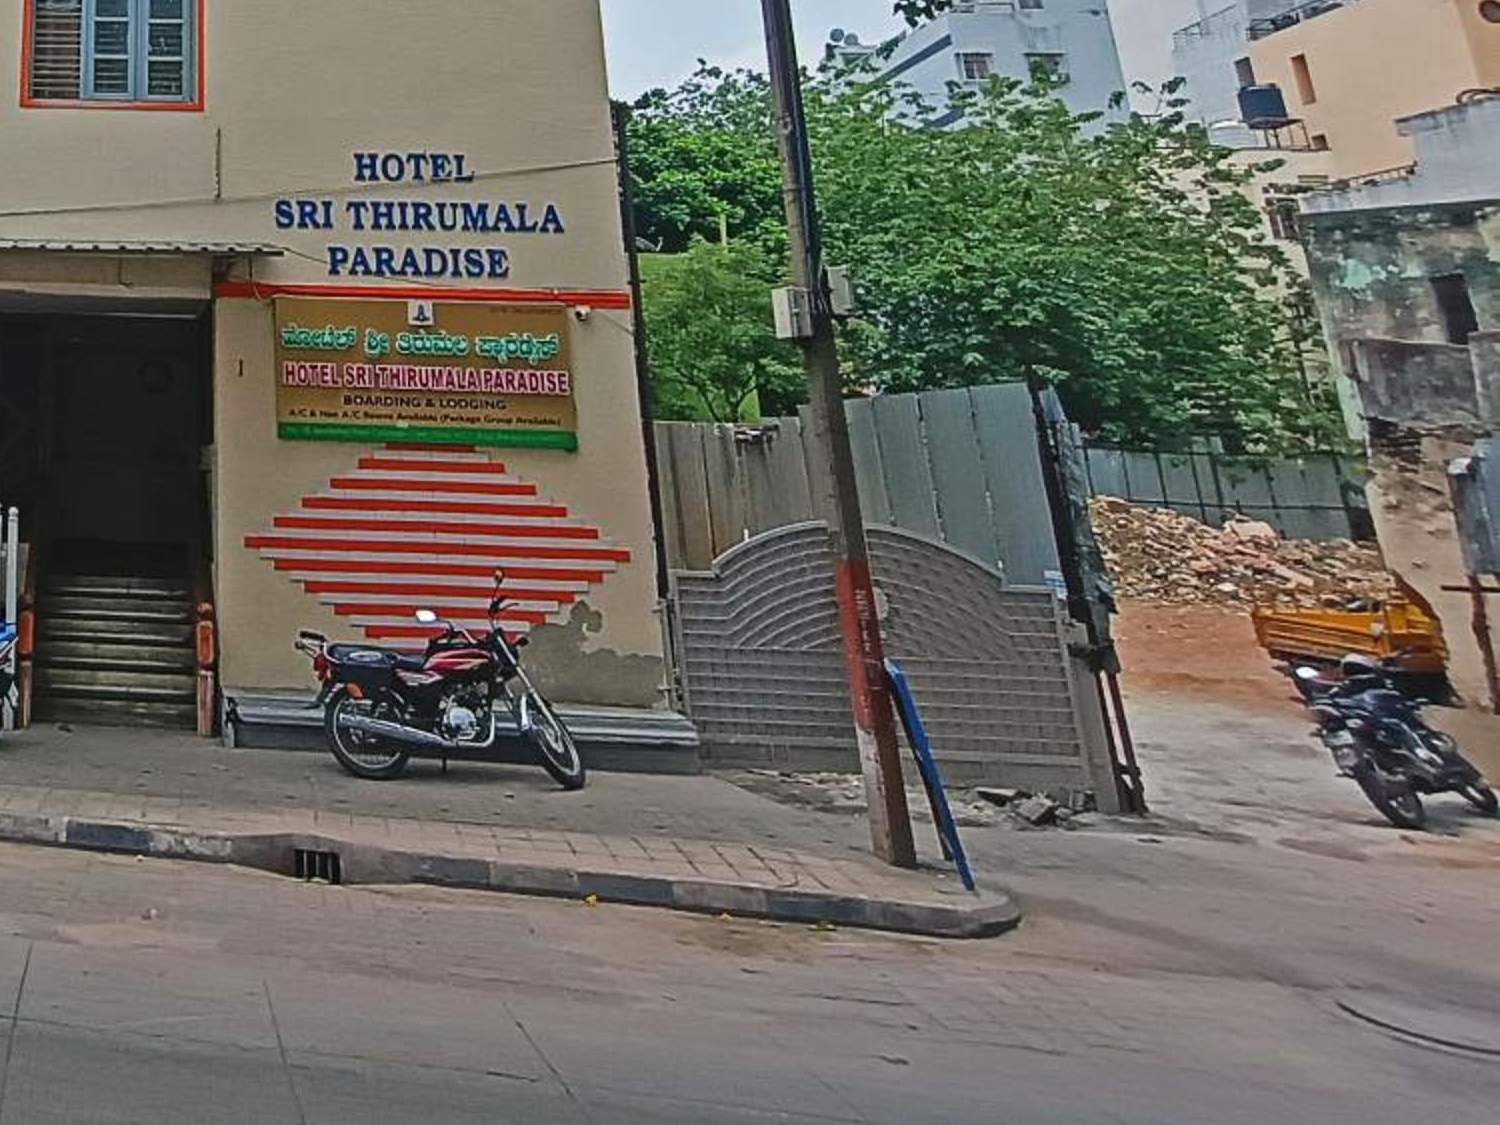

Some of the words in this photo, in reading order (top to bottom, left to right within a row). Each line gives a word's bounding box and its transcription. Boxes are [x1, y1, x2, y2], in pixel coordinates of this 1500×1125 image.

[353, 152, 474, 183] HOTEL
[274, 199, 333, 230] SRI
[346, 200, 564, 234] THIRUMALA
[328, 245, 510, 278] PARADISE
[284, 362, 340, 386] HOTEL
[343, 363, 374, 388] SRI
[377, 364, 481, 392] THIRUMALA
[482, 367, 570, 395] PARADISE
[343, 394, 421, 408] BOARDING
[425, 398, 435, 408] &
[438, 397, 508, 410] LODGING
